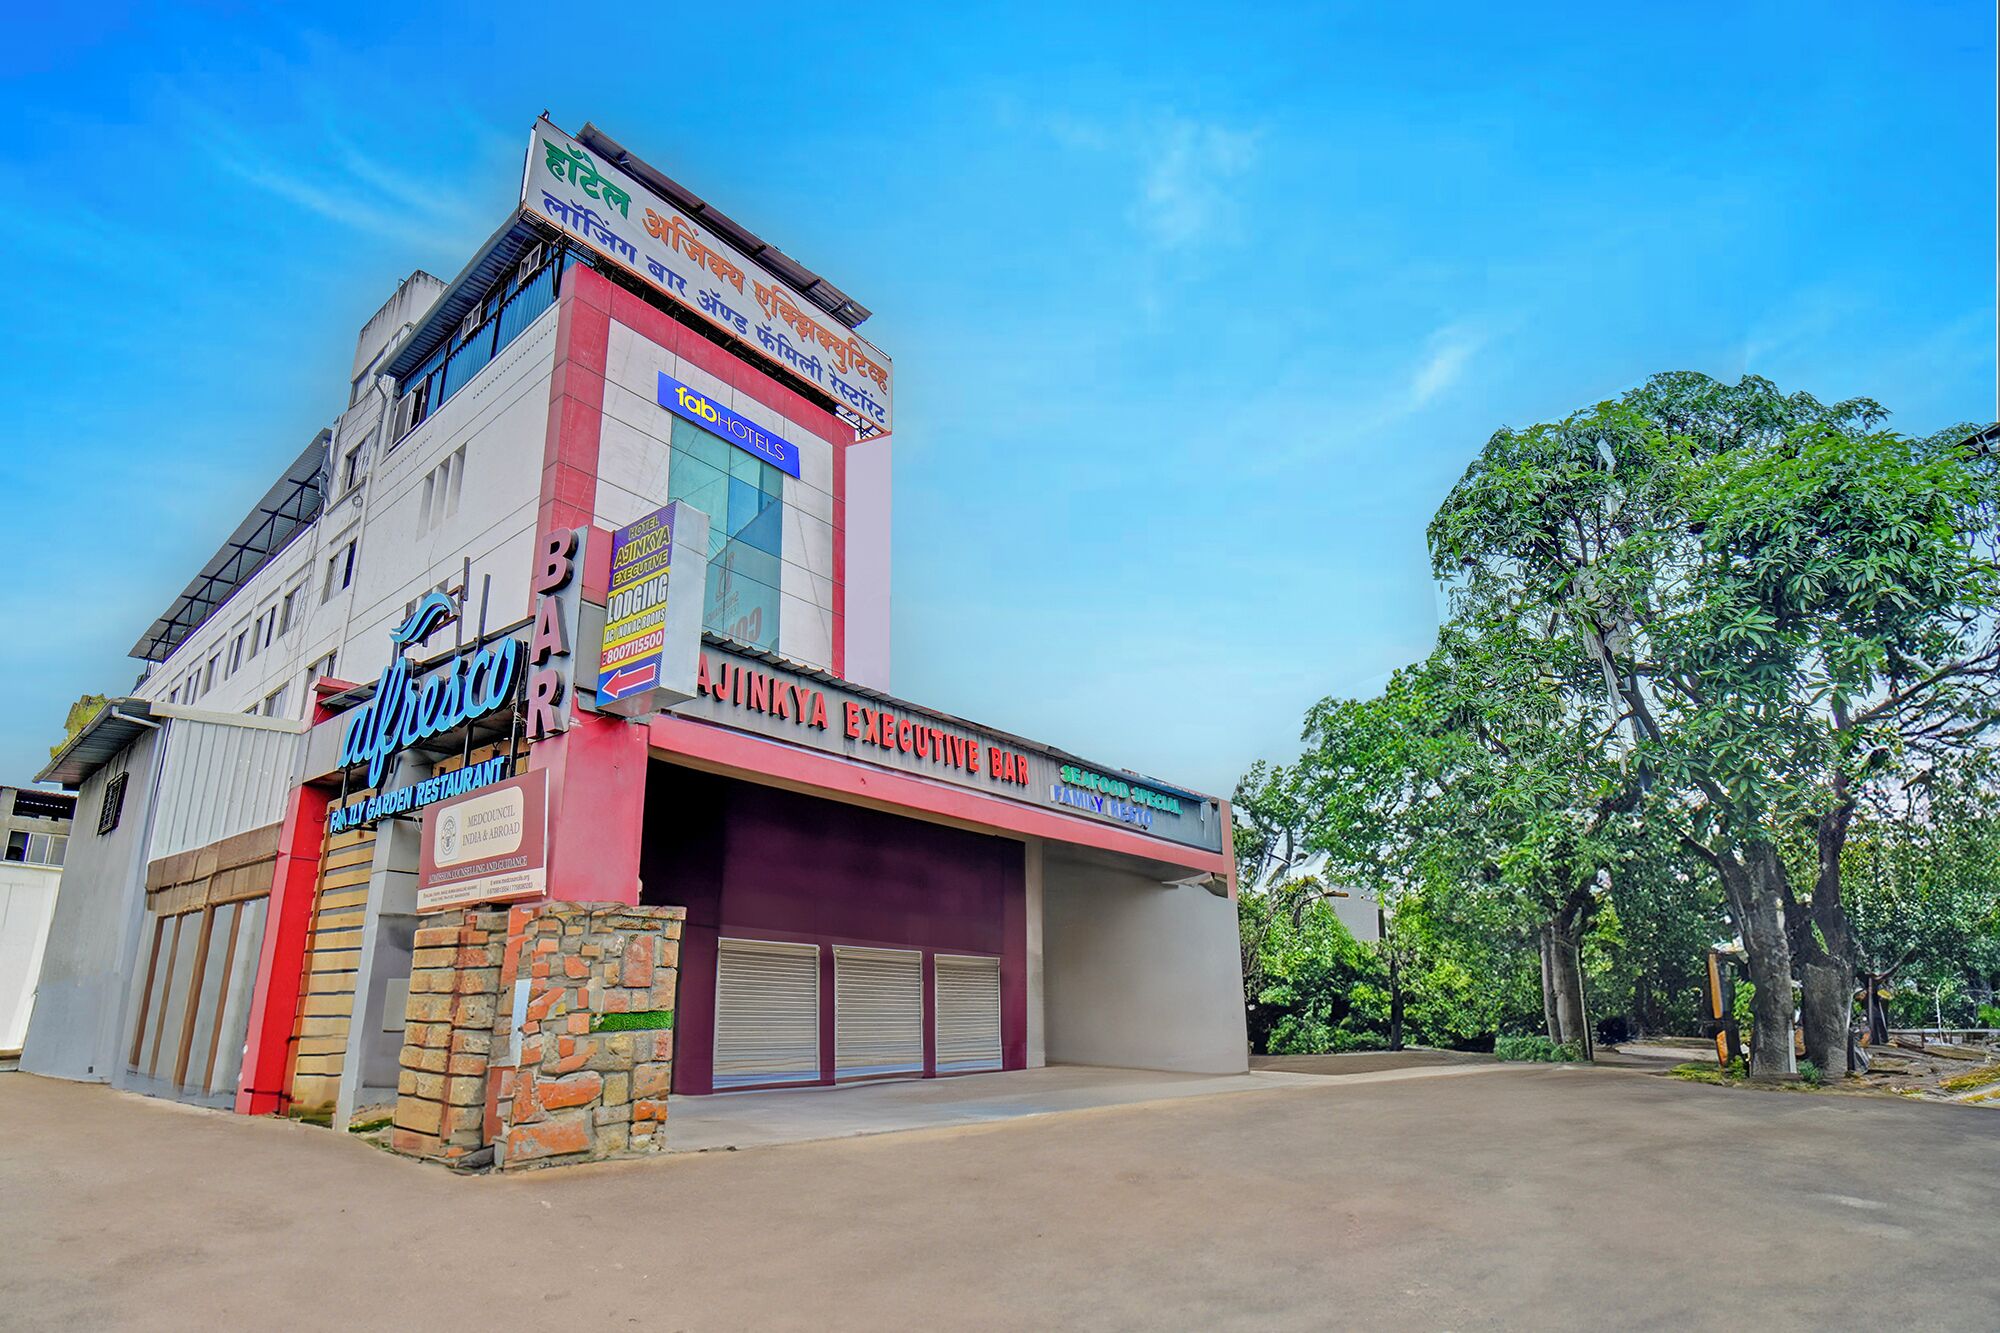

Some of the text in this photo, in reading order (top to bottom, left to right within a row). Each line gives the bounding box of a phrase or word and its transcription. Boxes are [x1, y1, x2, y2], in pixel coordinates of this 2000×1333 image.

[542, 138, 632, 220] हॉटेल
[541, 189, 638, 265] लॉजिंग
[645, 254, 688, 297] बार
[613, 525, 671, 569] AJINKYA
[628, 515, 659, 540] HOTEL
[612, 550, 668, 587] EXECUTIVE
[606, 572, 669, 626] LODGING
[641, 607, 666, 630] ROOMS
[527, 527, 575, 739] BAR
[606, 631, 663, 664] 8007115500
[338, 637, 516, 789] alfresco
[698, 652, 1029, 785] AJINKYA EXECUTIVE BAR
[366, 785, 414, 819] GARDEN
[415, 757, 505, 806] RESTAURANT
[1050, 784, 1103, 814] FAMILY
[1060, 765, 1184, 815] SEAFOOD SPECIAL
[462, 821, 520, 847] INDIA & ABROAD
[467, 805, 515, 828] MEDCOUNCIL
